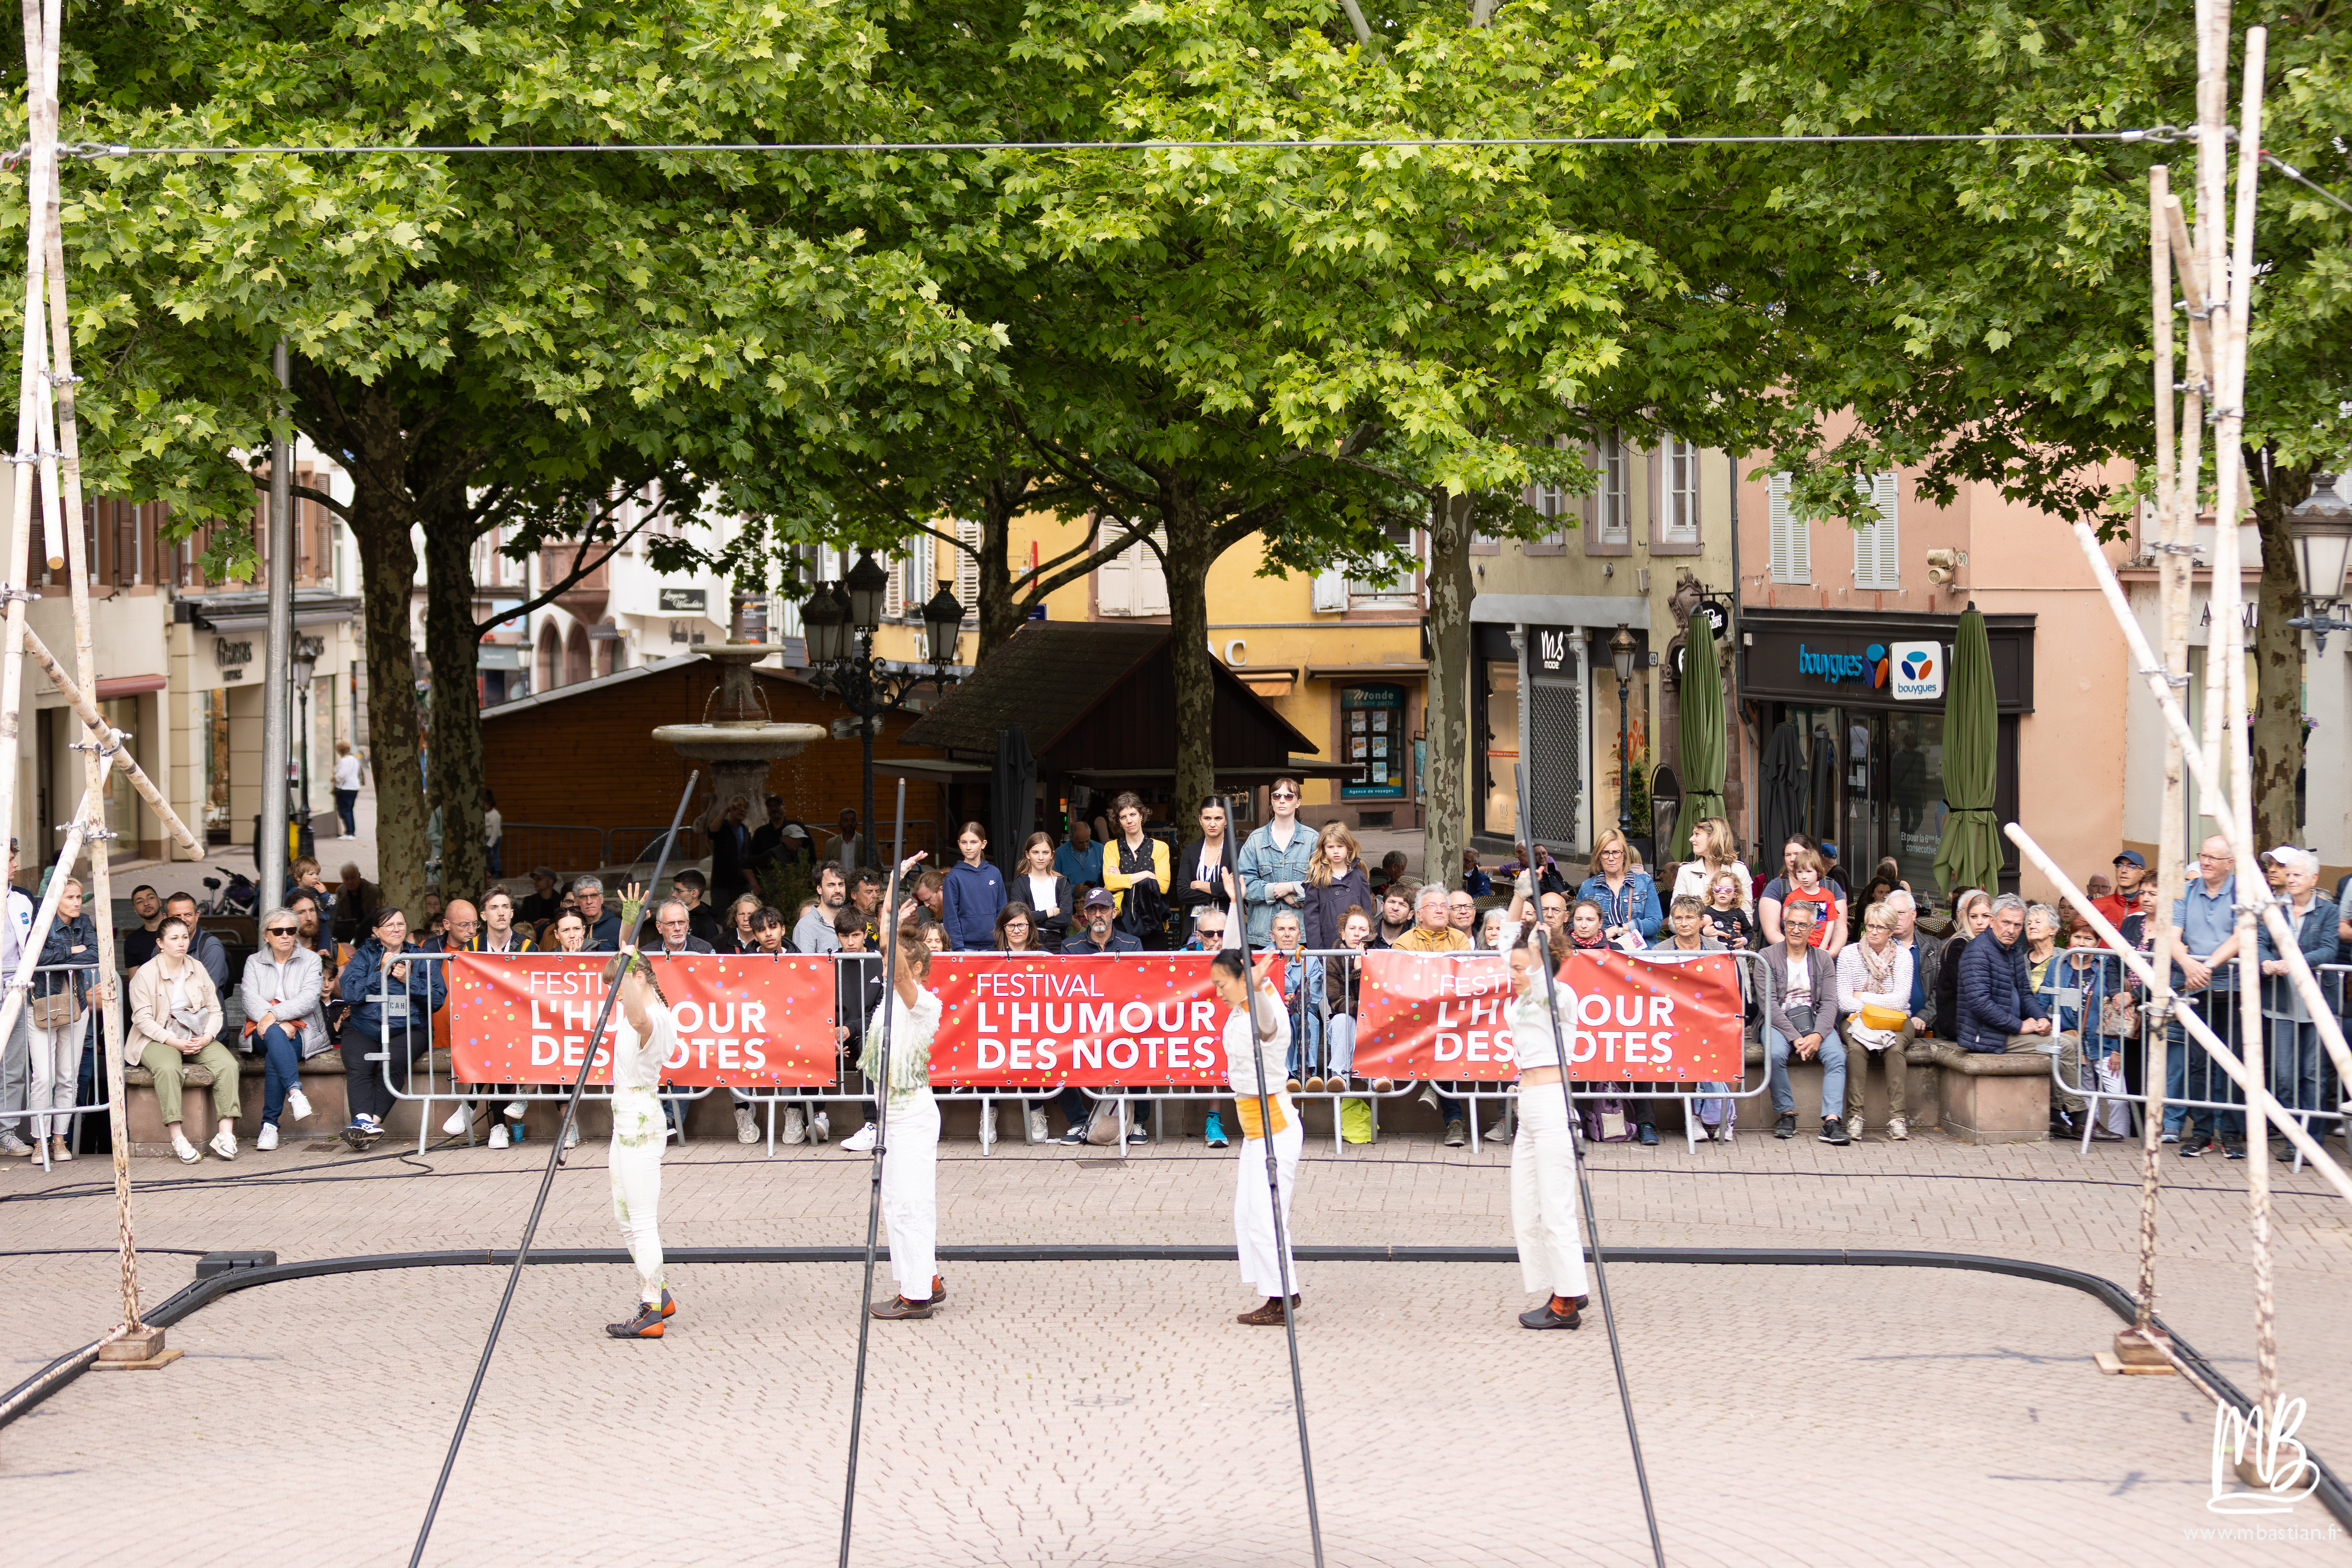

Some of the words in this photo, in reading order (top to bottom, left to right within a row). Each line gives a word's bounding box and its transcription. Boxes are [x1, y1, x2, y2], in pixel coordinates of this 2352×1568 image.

[1958, 554, 1966, 564] 90
[1799, 644, 1863, 683] bouygues
[1354, 689, 1394, 701] Monde
[1898, 683, 1937, 694] bouygues
[1901, 832, 1906, 841] Et
[1907, 834, 1919, 843] pour
[1920, 833, 1924, 842] la
[1906, 845, 1936, 855] consecutive
[530, 971, 602, 995] FESTI
[977, 973, 1104, 997] FESTIVAL
[1439, 973, 1512, 997] FESTI
[530, 999, 766, 1033] L'HUOUR
[978, 1001, 1216, 1034] L'HUMOUR
[1437, 994, 1675, 1028] L'HOUR
[662, 1038, 766, 1070] OTES
[977, 1038, 1057, 1070] DES
[1072, 1036, 1216, 1069] NOTES
[1434, 1030, 1515, 1063] DES
[1571, 1031, 1673, 1064] OTES
